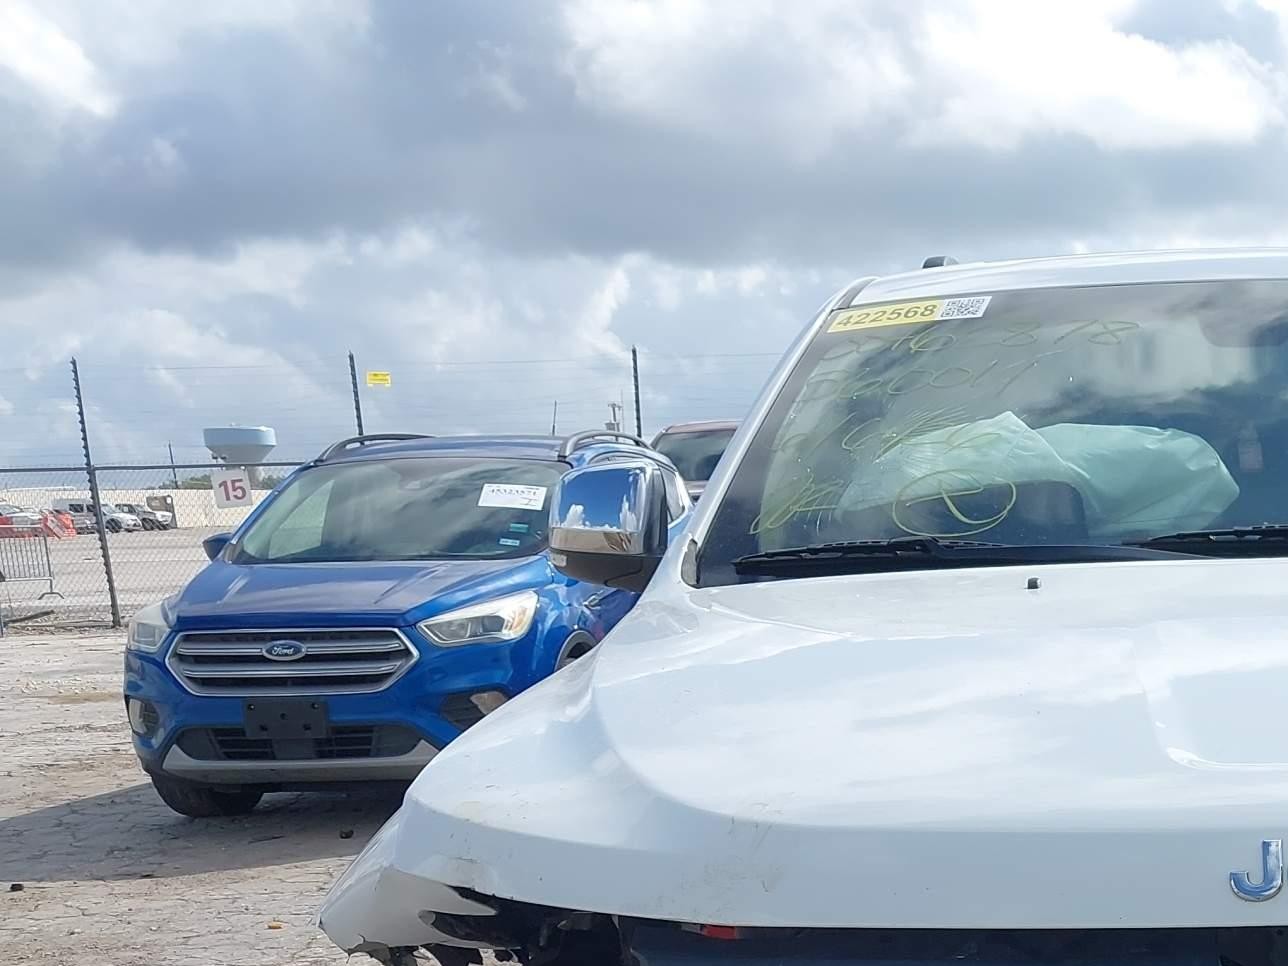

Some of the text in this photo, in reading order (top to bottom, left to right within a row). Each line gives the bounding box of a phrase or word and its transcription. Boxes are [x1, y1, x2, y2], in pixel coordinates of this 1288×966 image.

[836, 303, 939, 327] 422568
[218, 478, 247, 501] 15
[271, 645, 295, 656] Ford
